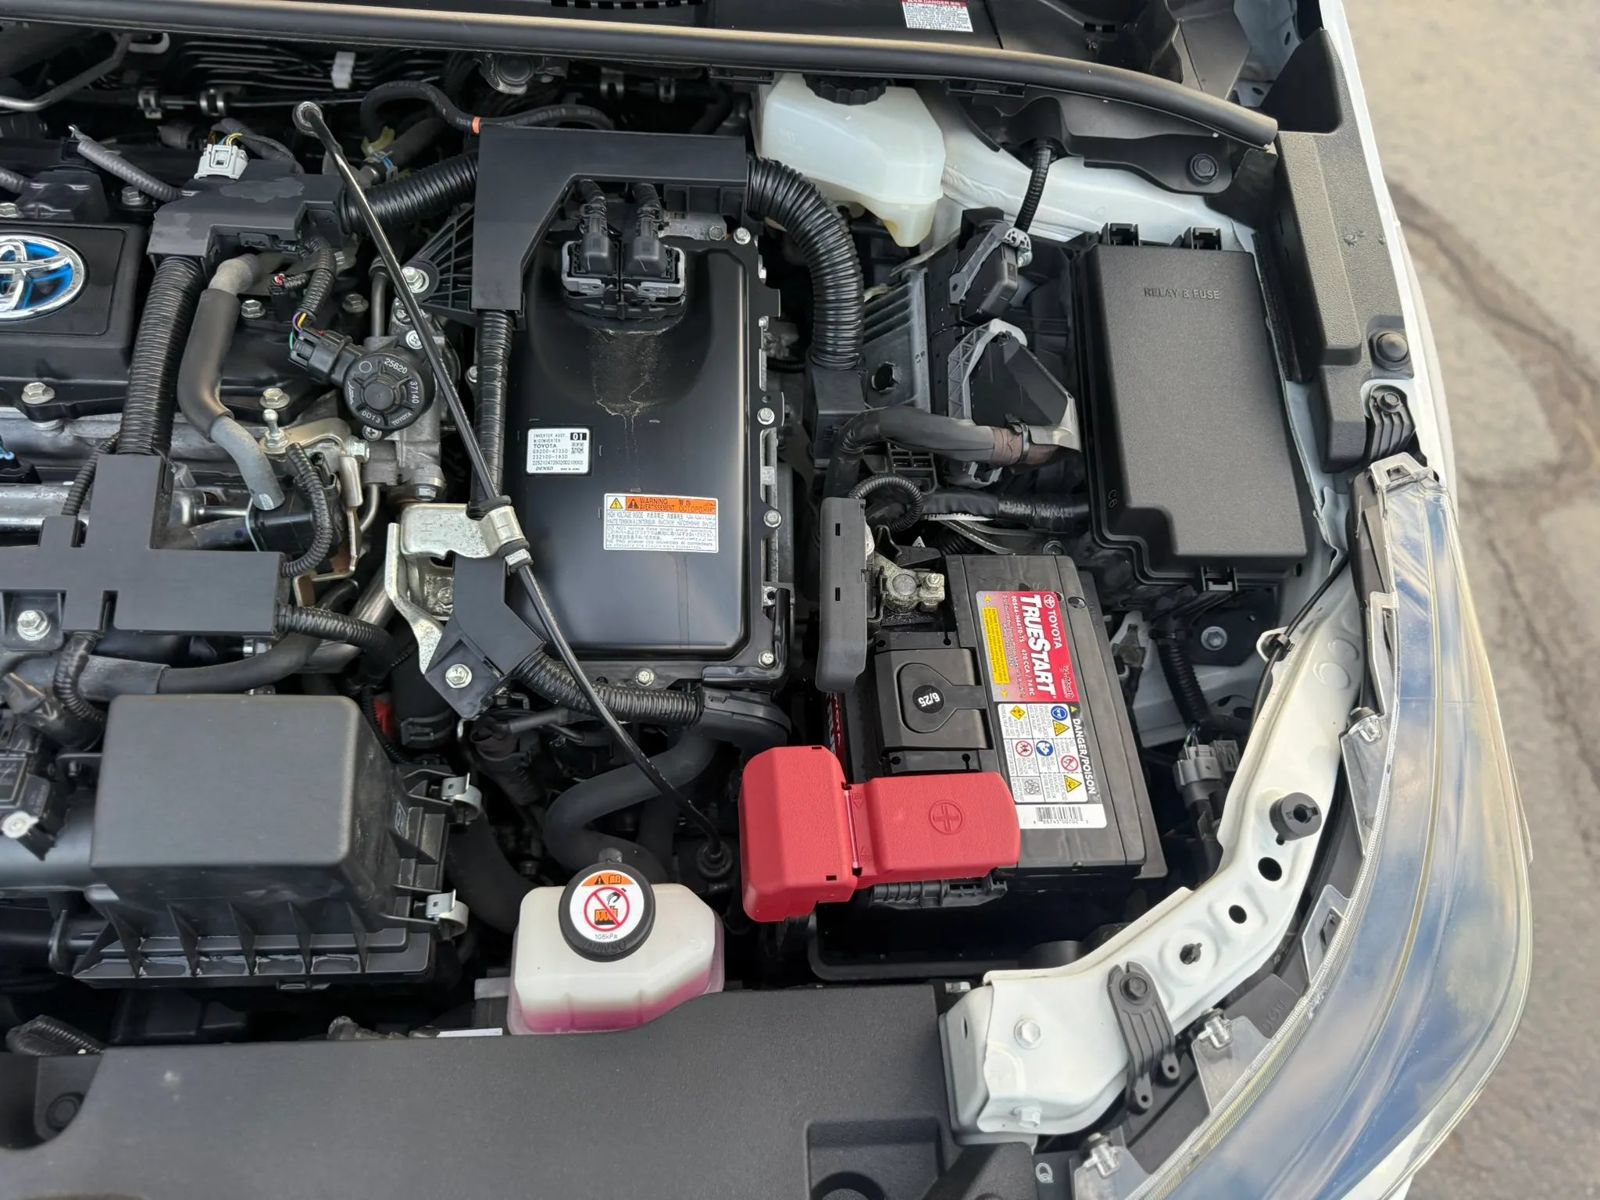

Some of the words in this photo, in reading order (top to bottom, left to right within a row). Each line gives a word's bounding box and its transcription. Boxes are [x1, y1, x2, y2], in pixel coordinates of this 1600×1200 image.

[1143, 287, 1177, 298] RELAY
[1182, 288, 1190, 298] &
[1193, 288, 1221, 300] FUSE
[384, 358, 408, 374] 25620
[410, 381, 420, 404] 37140
[391, 411, 413, 426] TOYOTA
[572, 432, 583, 441] 01
[1047, 610, 1063, 649] TOYOTA
[1023, 660, 1031, 674] CCA
[918, 692, 941, 708] 6/25
[1072, 718, 1097, 795] DANGER/POISON
